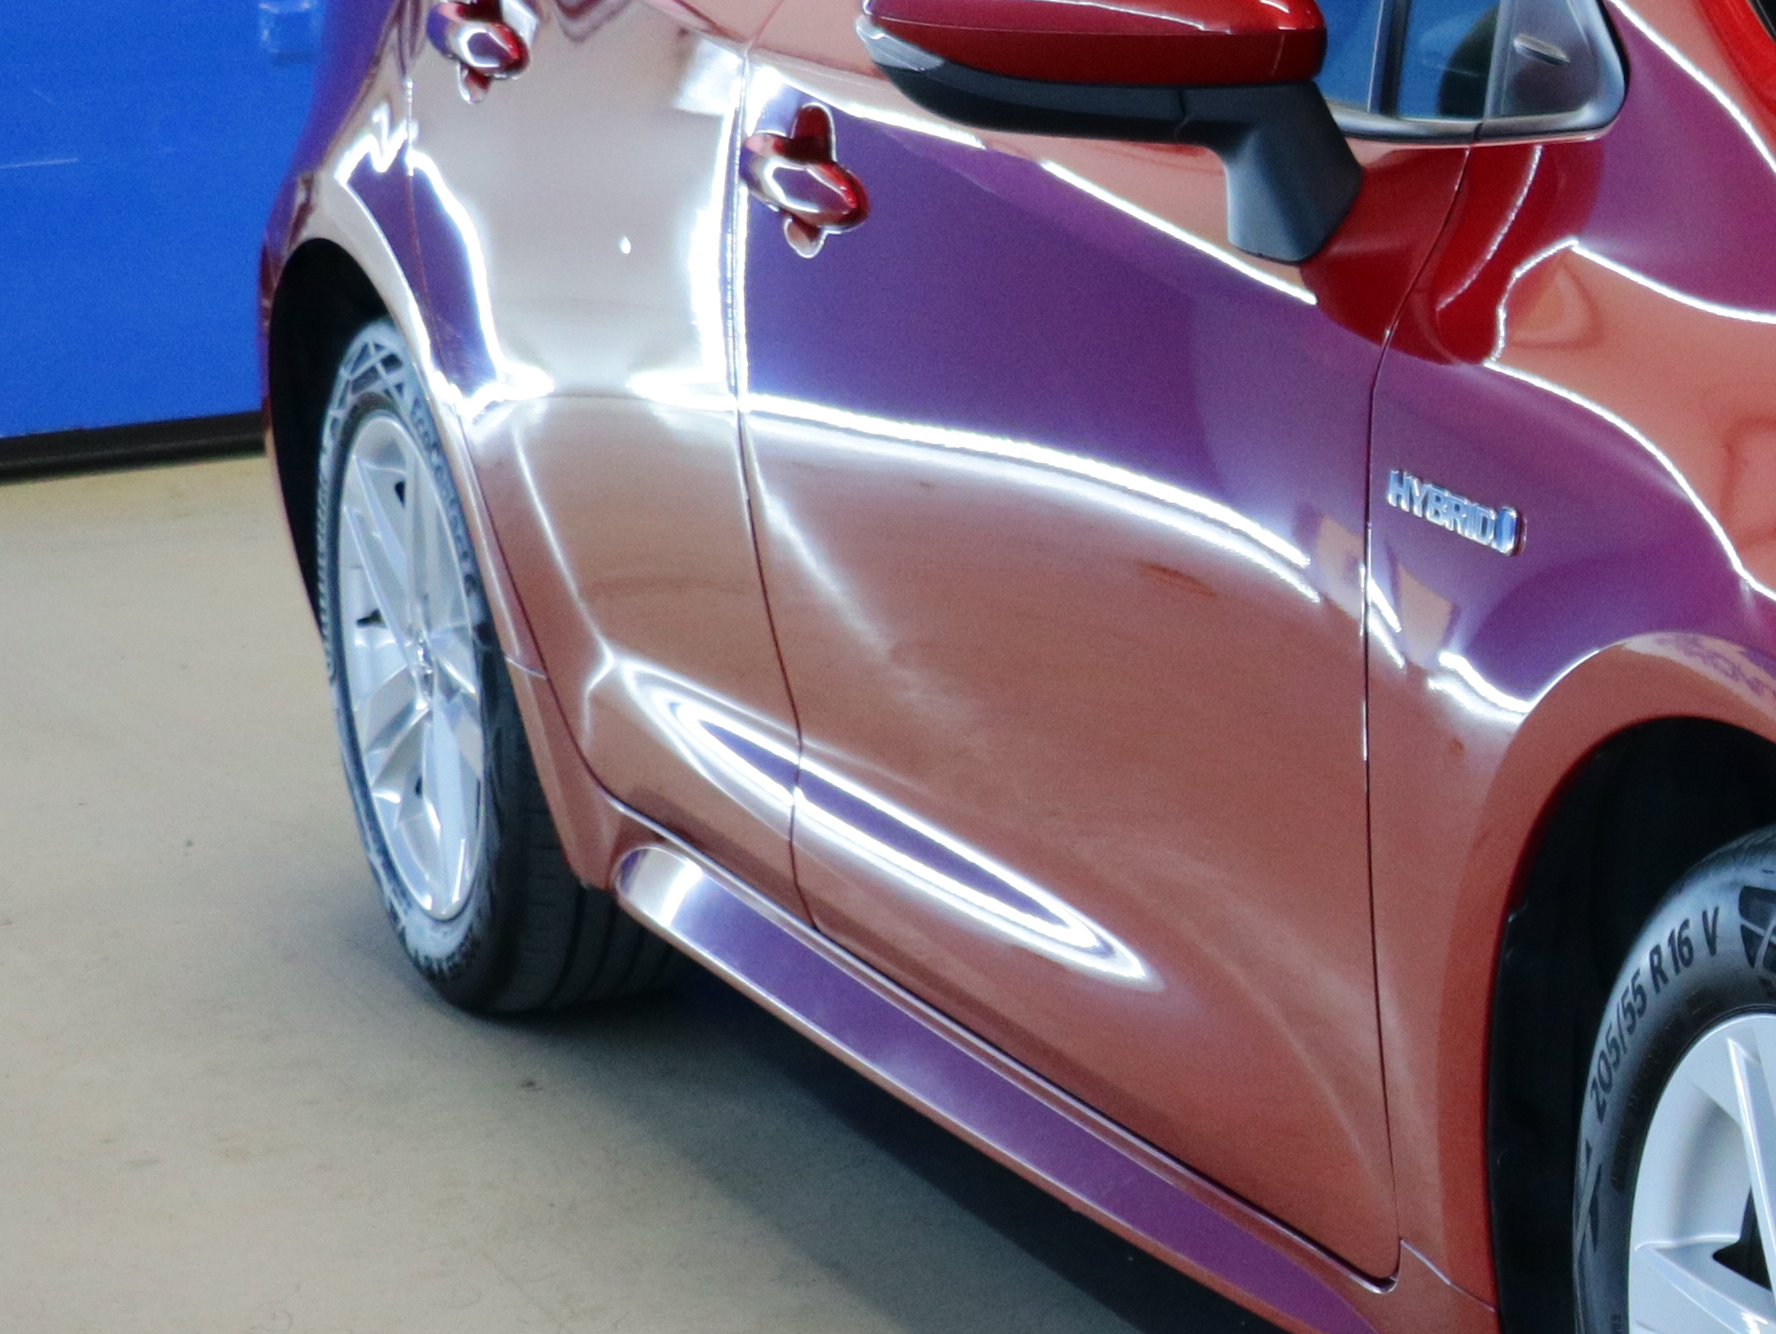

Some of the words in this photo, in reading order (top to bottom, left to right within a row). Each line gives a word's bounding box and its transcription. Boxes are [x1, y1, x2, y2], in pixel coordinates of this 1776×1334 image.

[1387, 469, 1498, 546] HYBRID
[1590, 968, 1648, 1125] 205/55
[1649, 943, 1669, 995] R
[1667, 918, 1695, 977] 16
[1702, 906, 1720, 957] V
